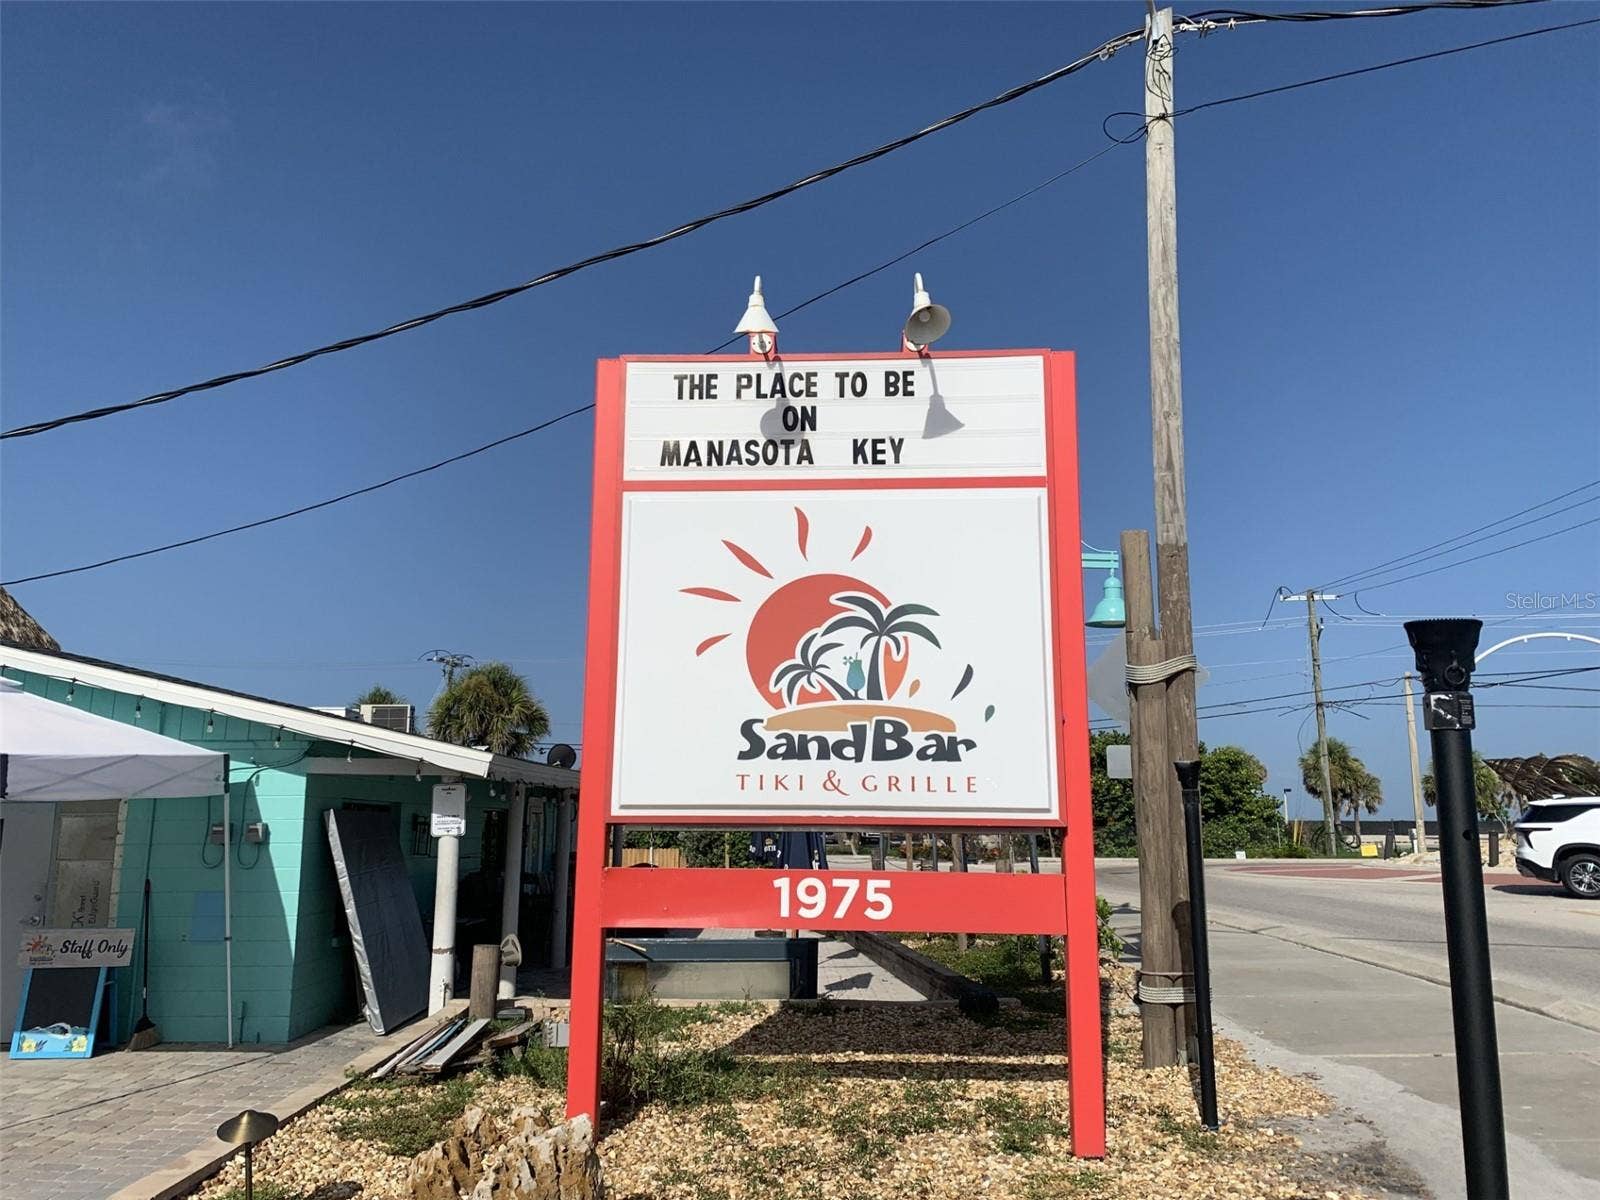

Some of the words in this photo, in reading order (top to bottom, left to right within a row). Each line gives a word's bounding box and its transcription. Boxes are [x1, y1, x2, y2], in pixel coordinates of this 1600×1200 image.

[673, 373, 718, 400] THE
[735, 371, 818, 400] PLACE
[835, 371, 867, 398] TO
[884, 370, 915, 397] BE
[782, 405, 817, 432] ON
[660, 438, 814, 467] MANASOTA
[852, 437, 904, 465] KEY
[736, 774, 803, 791] TIKI
[822, 770, 850, 796] &
[861, 775, 977, 793] GRILLE
[772, 877, 893, 920] 1975
[60, 939, 93, 959] Staff
[97, 939, 128, 958] Only
